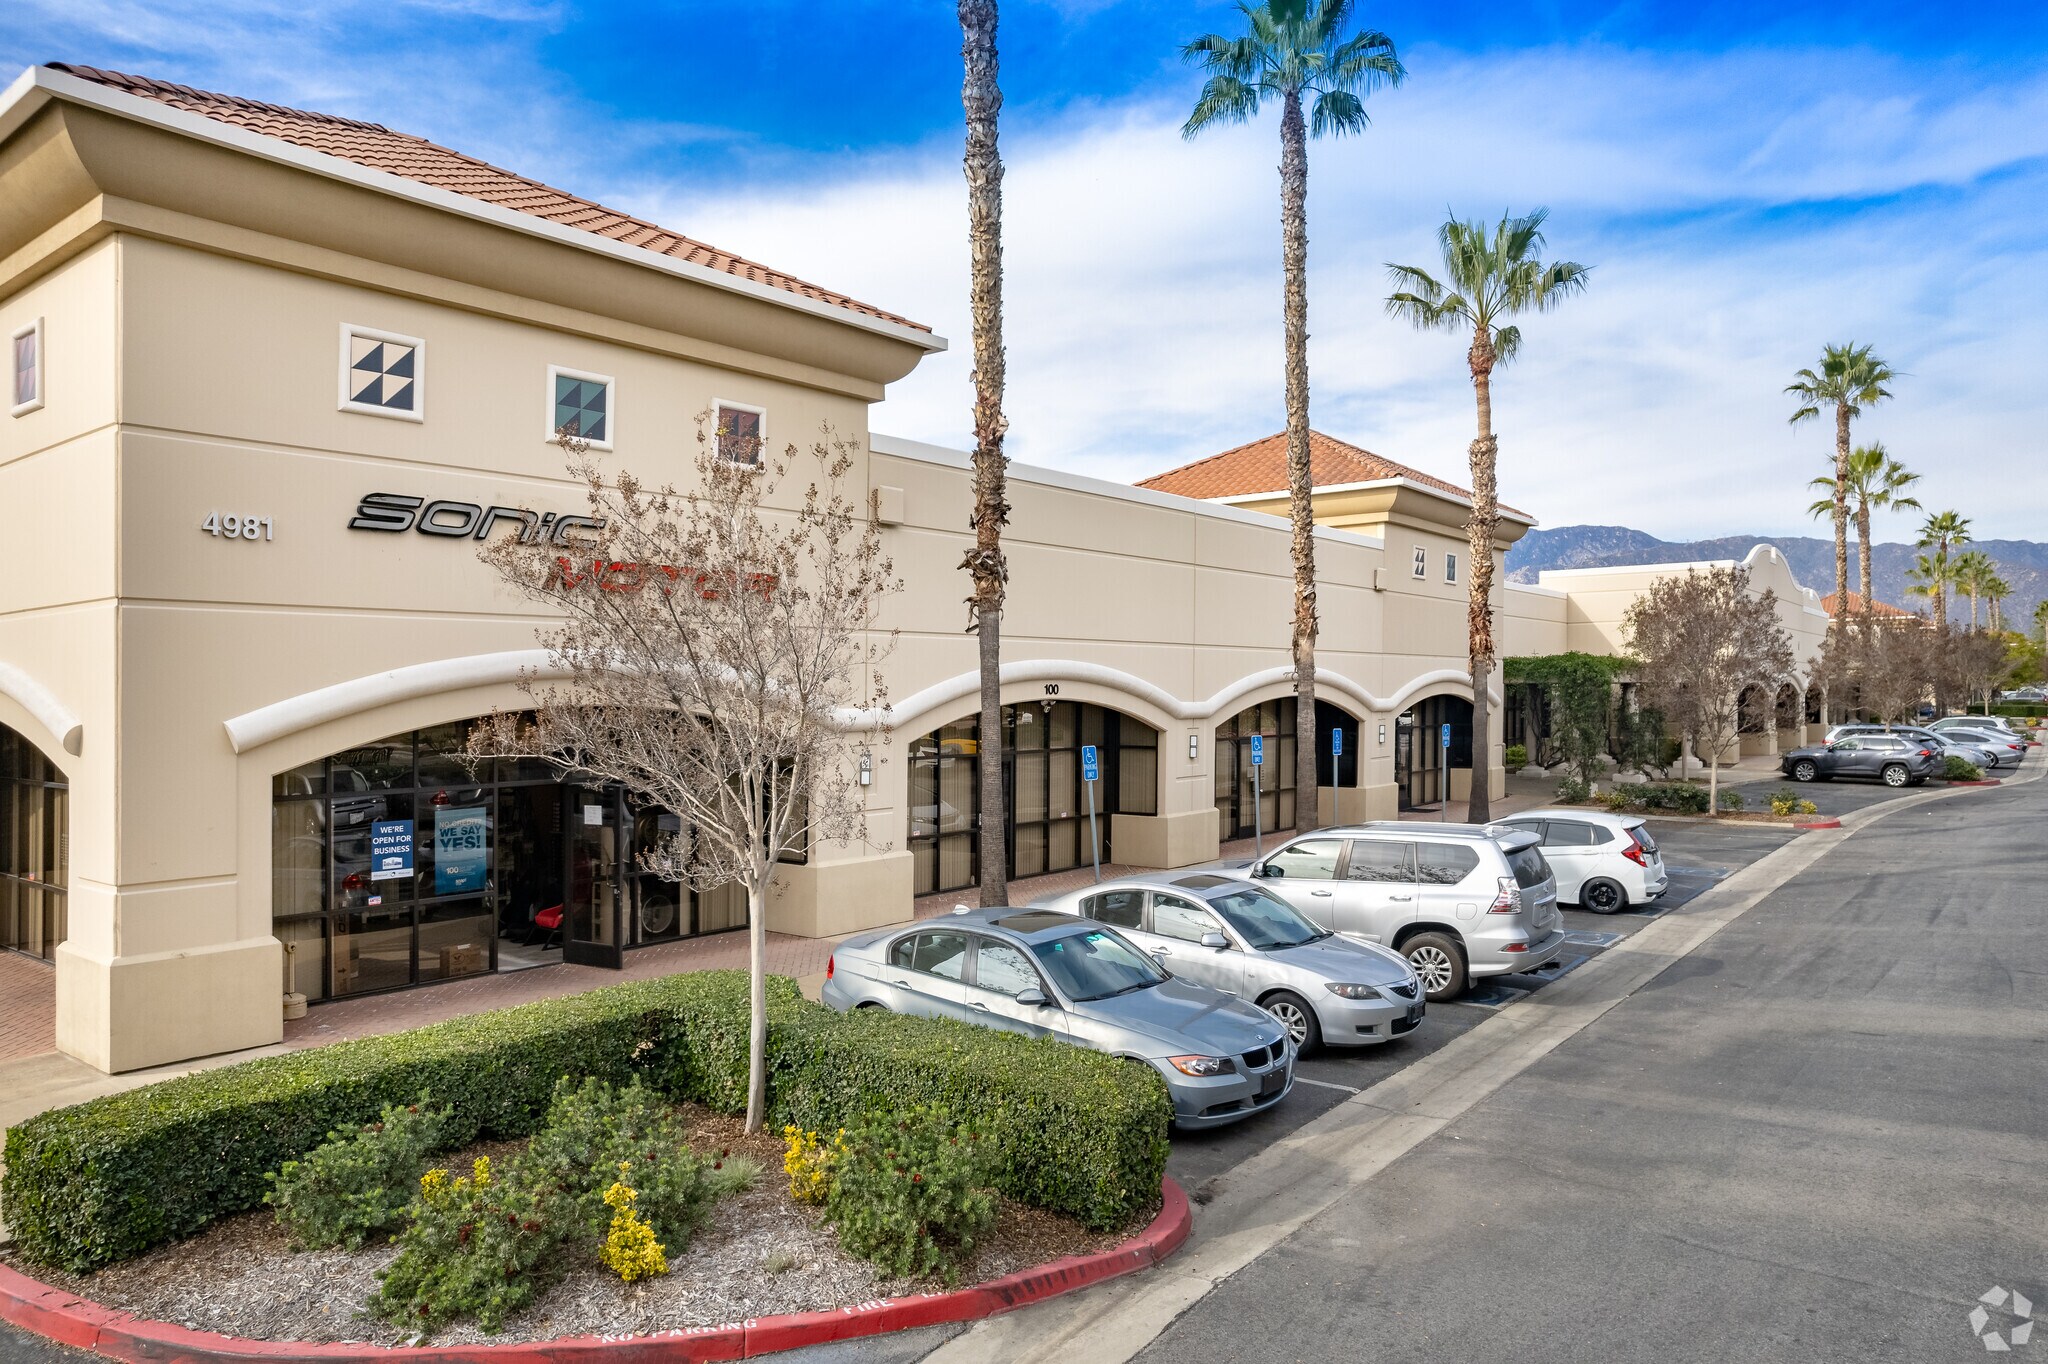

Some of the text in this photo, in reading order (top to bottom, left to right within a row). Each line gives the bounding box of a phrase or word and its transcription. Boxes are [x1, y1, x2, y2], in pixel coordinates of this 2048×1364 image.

[201, 511, 274, 541] 4981
[1044, 684, 1059, 695] 100
[380, 825, 404, 834] WE'RE
[440, 825, 481, 837] WE SAY
[372, 836, 394, 845] OPEN
[440, 835, 481, 852] YES!
[374, 845, 410, 855] BUSINESS
[843, 1298, 894, 1314] FIRE
